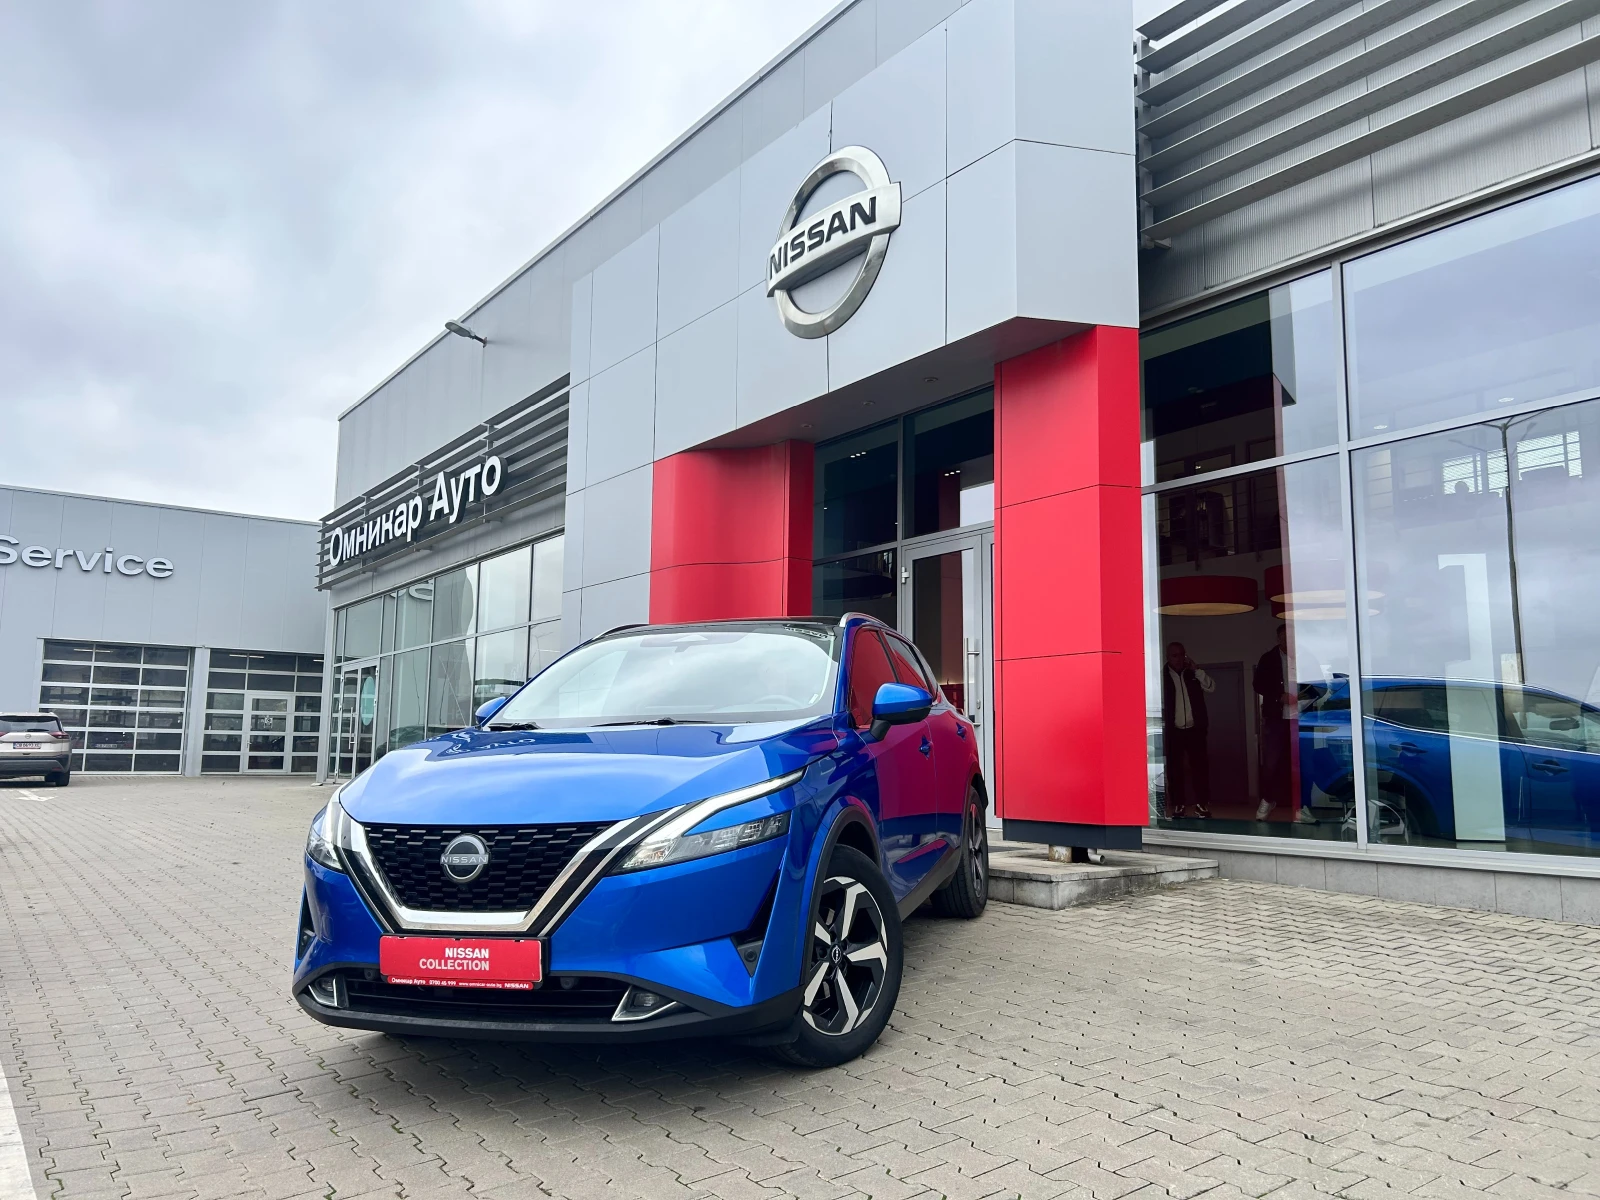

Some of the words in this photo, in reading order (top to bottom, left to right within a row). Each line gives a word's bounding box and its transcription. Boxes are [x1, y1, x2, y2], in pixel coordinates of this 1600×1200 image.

[769, 196, 877, 280] NISSAN
[329, 495, 424, 567] Омникар
[429, 455, 504, 524] Ауто
[0, 534, 174, 578] Service
[441, 856, 487, 864] NISSAN
[419, 958, 490, 971] COLLECTION
[445, 947, 490, 959] NISSAN
